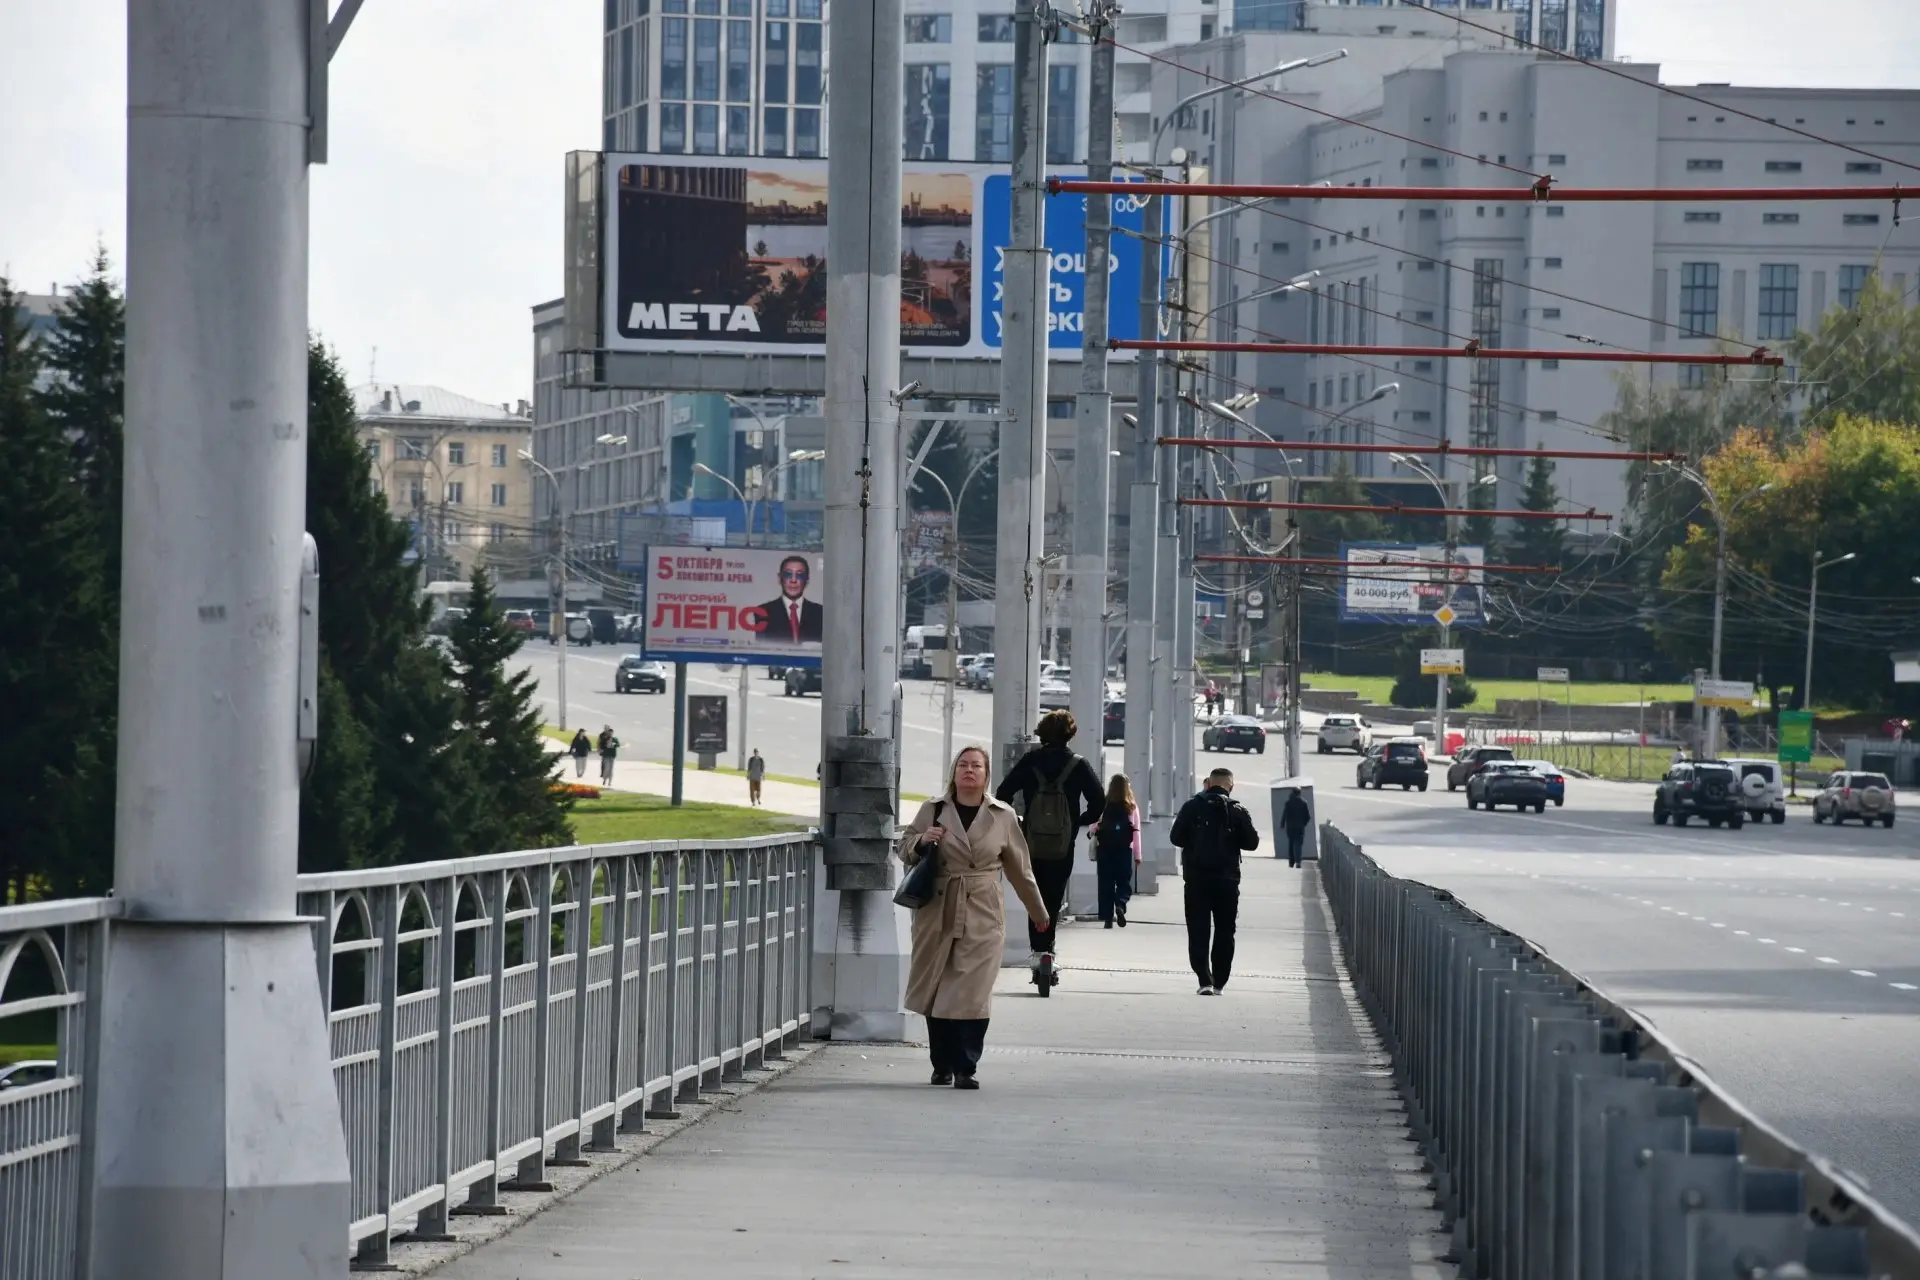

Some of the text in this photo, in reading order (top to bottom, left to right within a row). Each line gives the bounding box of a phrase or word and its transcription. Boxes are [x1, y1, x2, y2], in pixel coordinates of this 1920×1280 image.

[627, 302, 761, 332] МЕТА
[656, 555, 674, 580] 5
[676, 556, 723, 569] ОКТЯБРЯ
[727, 573, 754, 583] АРЕНА
[656, 592, 727, 603] ГРИГОРИЙ
[1368, 588, 1388, 598] 000
[651, 603, 769, 632] ЛЕПС
